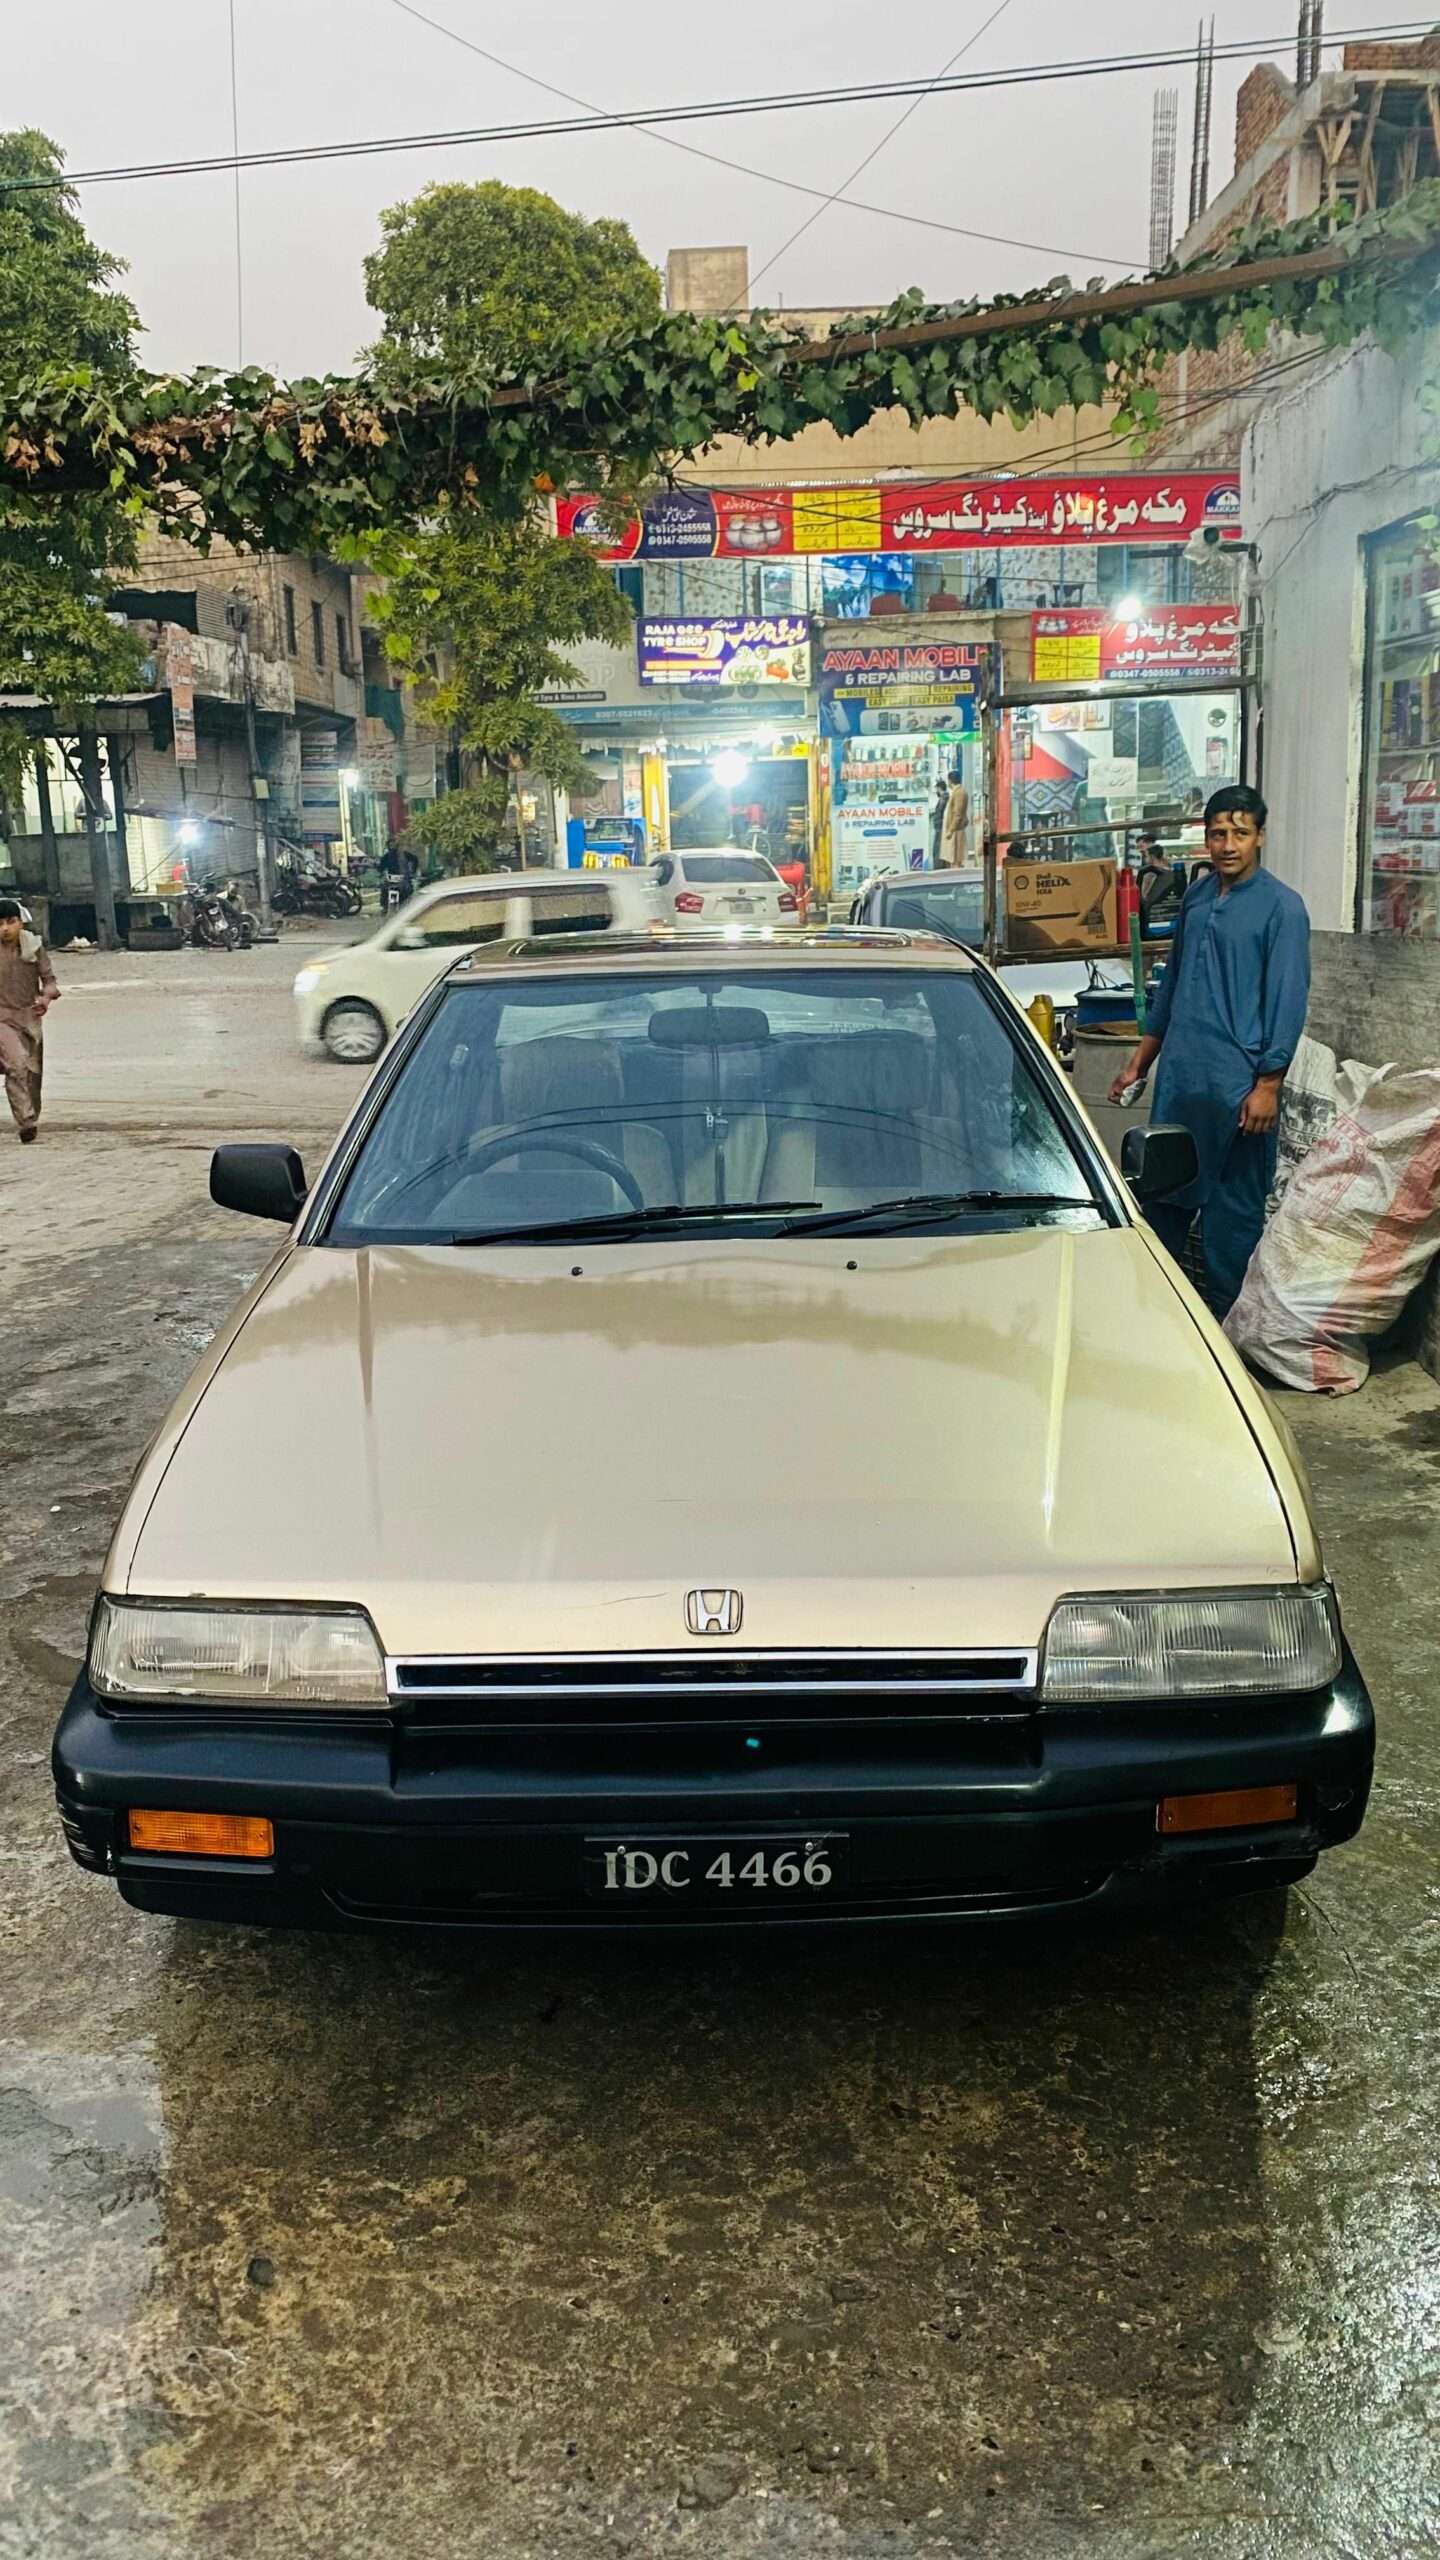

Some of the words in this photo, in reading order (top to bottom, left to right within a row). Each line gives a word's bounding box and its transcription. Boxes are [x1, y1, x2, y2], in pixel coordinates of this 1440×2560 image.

[1051, 489, 1096, 540] پلاؤ
[1096, 485, 1140, 535] مرغ
[1141, 486, 1187, 525] مکہ
[892, 505, 952, 541] سروس
[644, 624, 676, 636] RAJA
[675, 636, 707, 648] SHOP
[822, 648, 900, 672] AYAAN
[845, 673, 855, 685] &
[857, 670, 935, 685] REPAIRING
[939, 668, 972, 682] LAB
[838, 807, 876, 818] AYAAN
[879, 806, 924, 817] MOBILE
[852, 819, 896, 828] REPAIRING
[897, 818, 916, 826] LAB
[1036, 875, 1072, 889] HELIX
[603, 1850, 691, 1889] IDC
[705, 1850, 833, 1888] 4466
